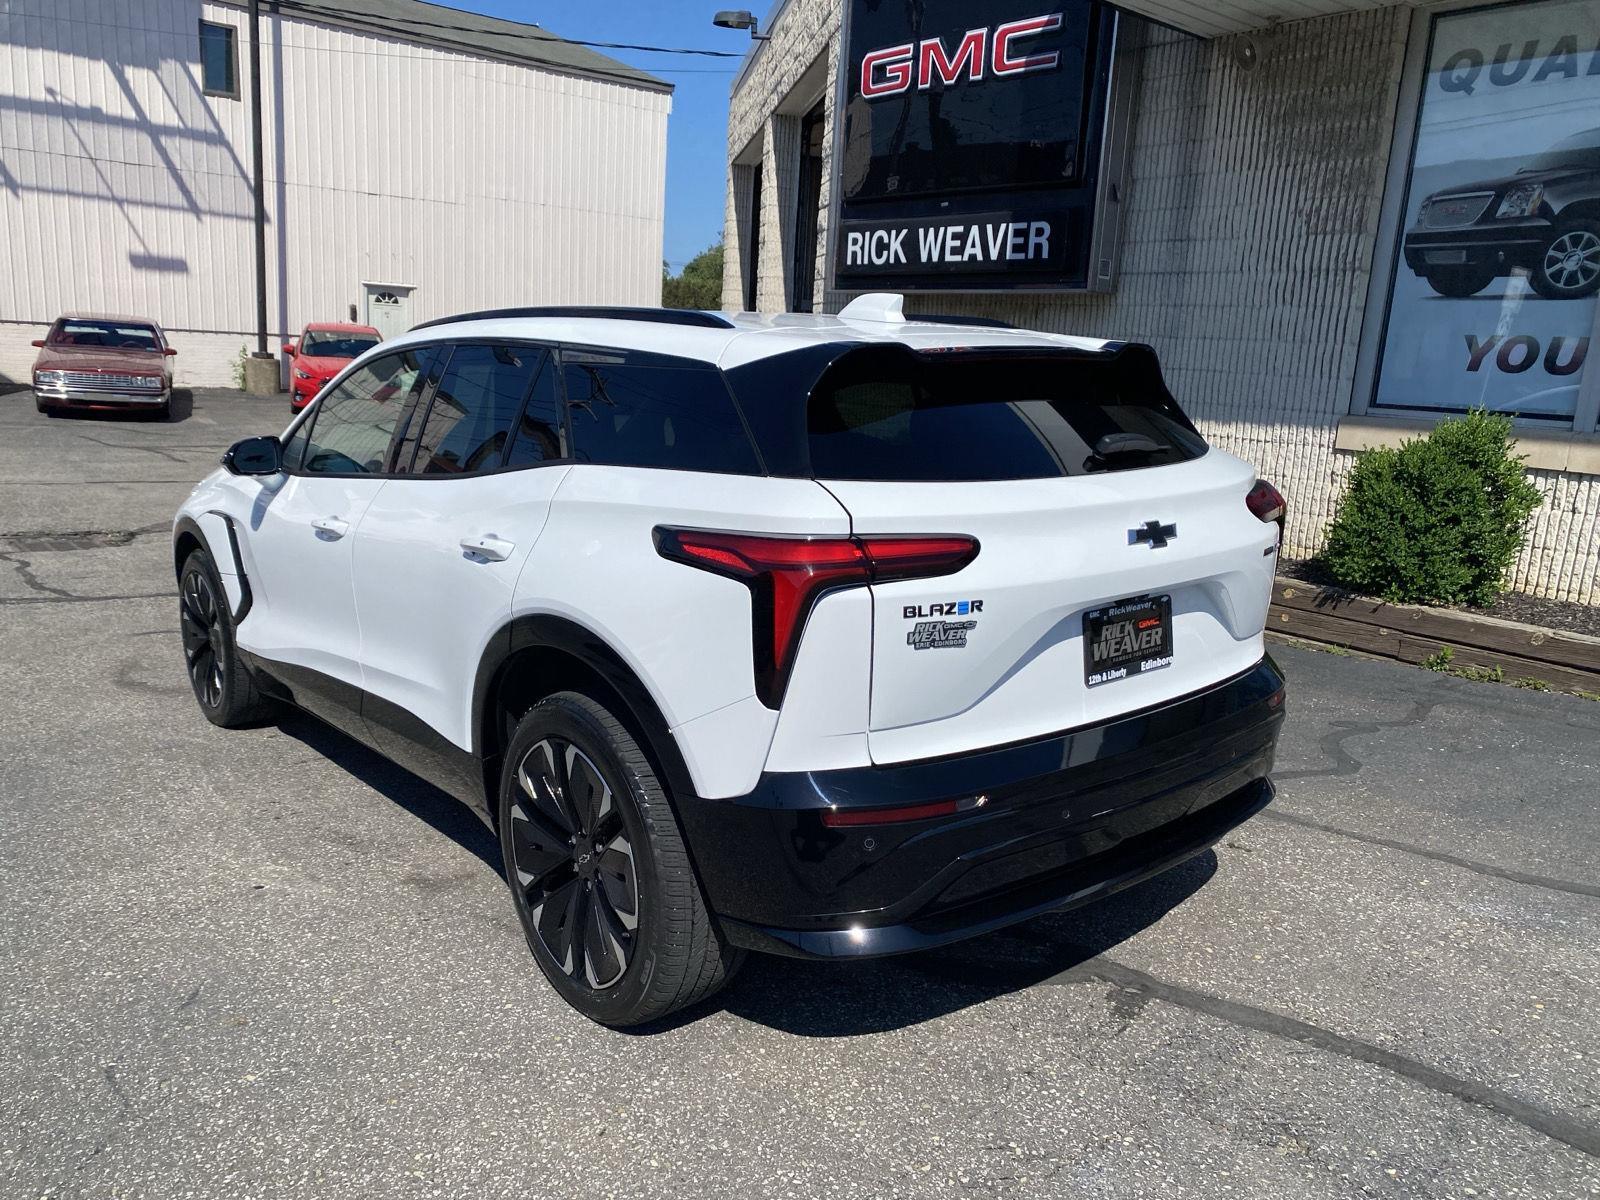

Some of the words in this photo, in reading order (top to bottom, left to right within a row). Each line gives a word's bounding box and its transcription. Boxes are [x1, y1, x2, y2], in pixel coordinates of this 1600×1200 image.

[861, 13, 1064, 99] GMC
[846, 229, 908, 265] RICK
[918, 221, 1050, 263] WEAVER
[1464, 334, 1590, 376] YOU
[903, 600, 983, 619] BLAZER
[908, 628, 967, 644] WEAVER
[915, 622, 943, 633] RICK
[1101, 619, 1136, 641] RICK
[1139, 618, 1160, 628] GMC
[915, 641, 931, 649] ERIE
[934, 638, 967, 647] EDINBORO
[1093, 627, 1163, 662] WEAVER
[1141, 656, 1174, 671] Edinboro
[1088, 674, 1102, 685] 12th
[1107, 667, 1127, 679] Liberty
